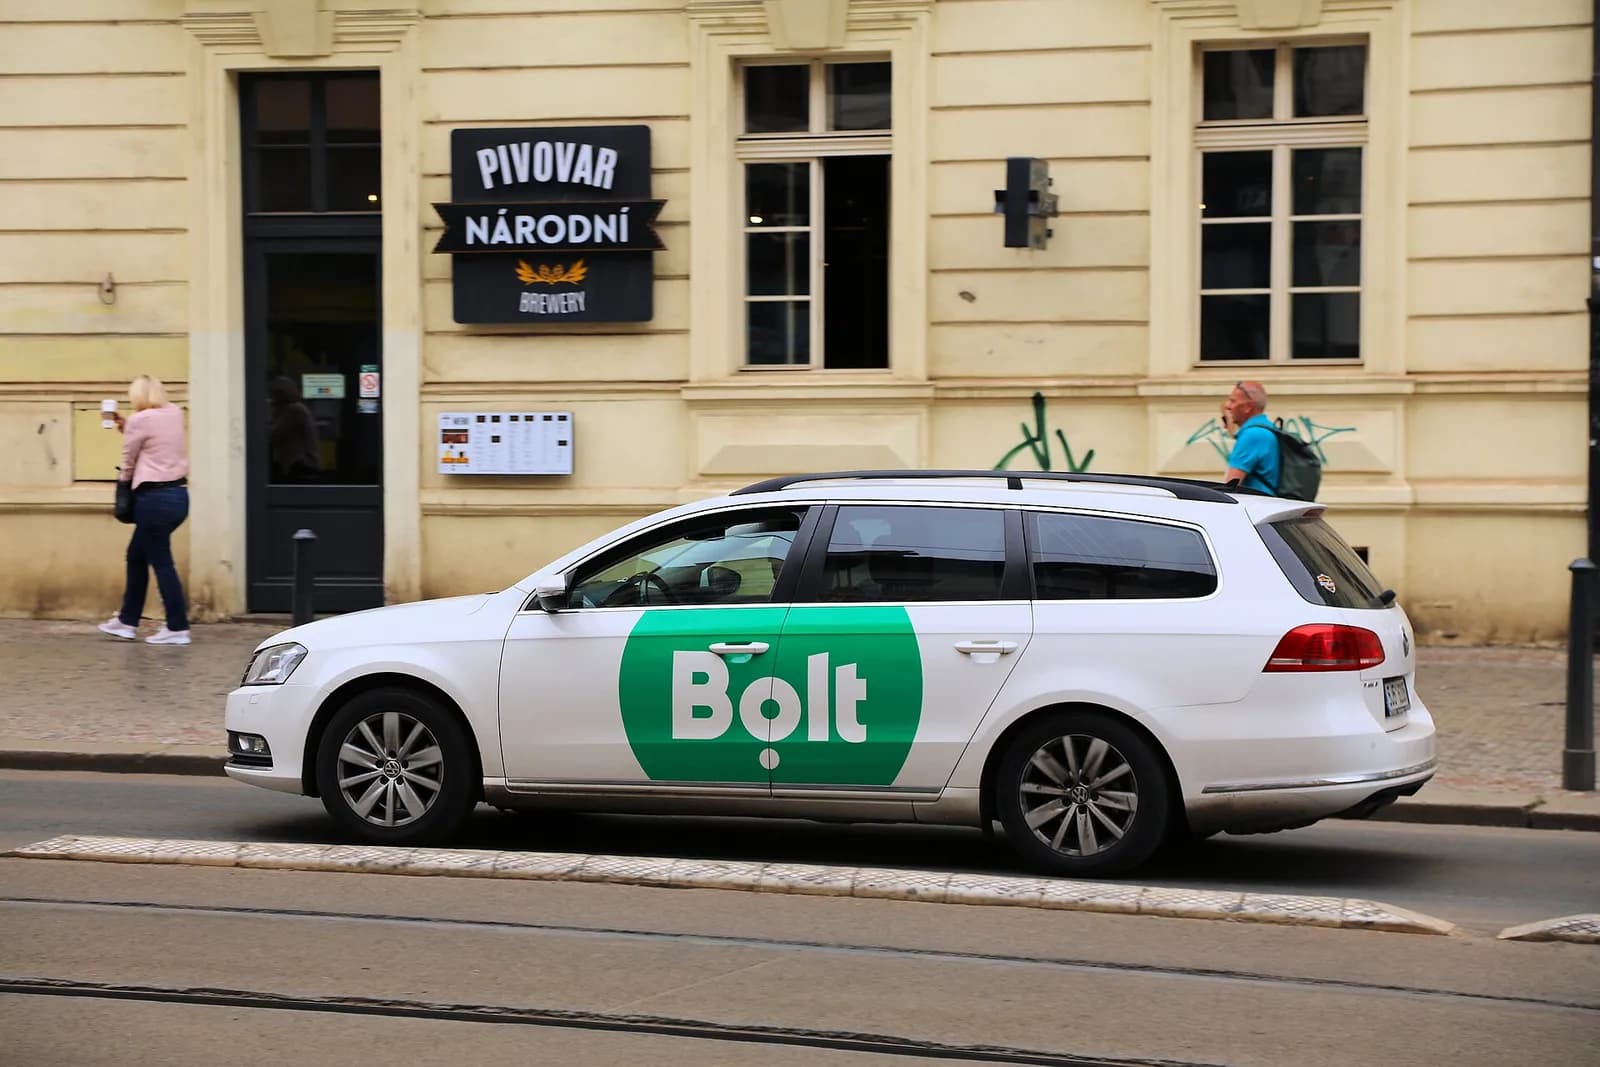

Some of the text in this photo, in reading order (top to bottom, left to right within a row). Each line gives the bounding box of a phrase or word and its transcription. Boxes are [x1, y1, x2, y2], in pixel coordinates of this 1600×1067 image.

[476, 141, 618, 189] PIVOVAR
[465, 206, 630, 245] NÁRODNÍ
[518, 291, 586, 314] BREWERY
[672, 650, 867, 744] Bolt
